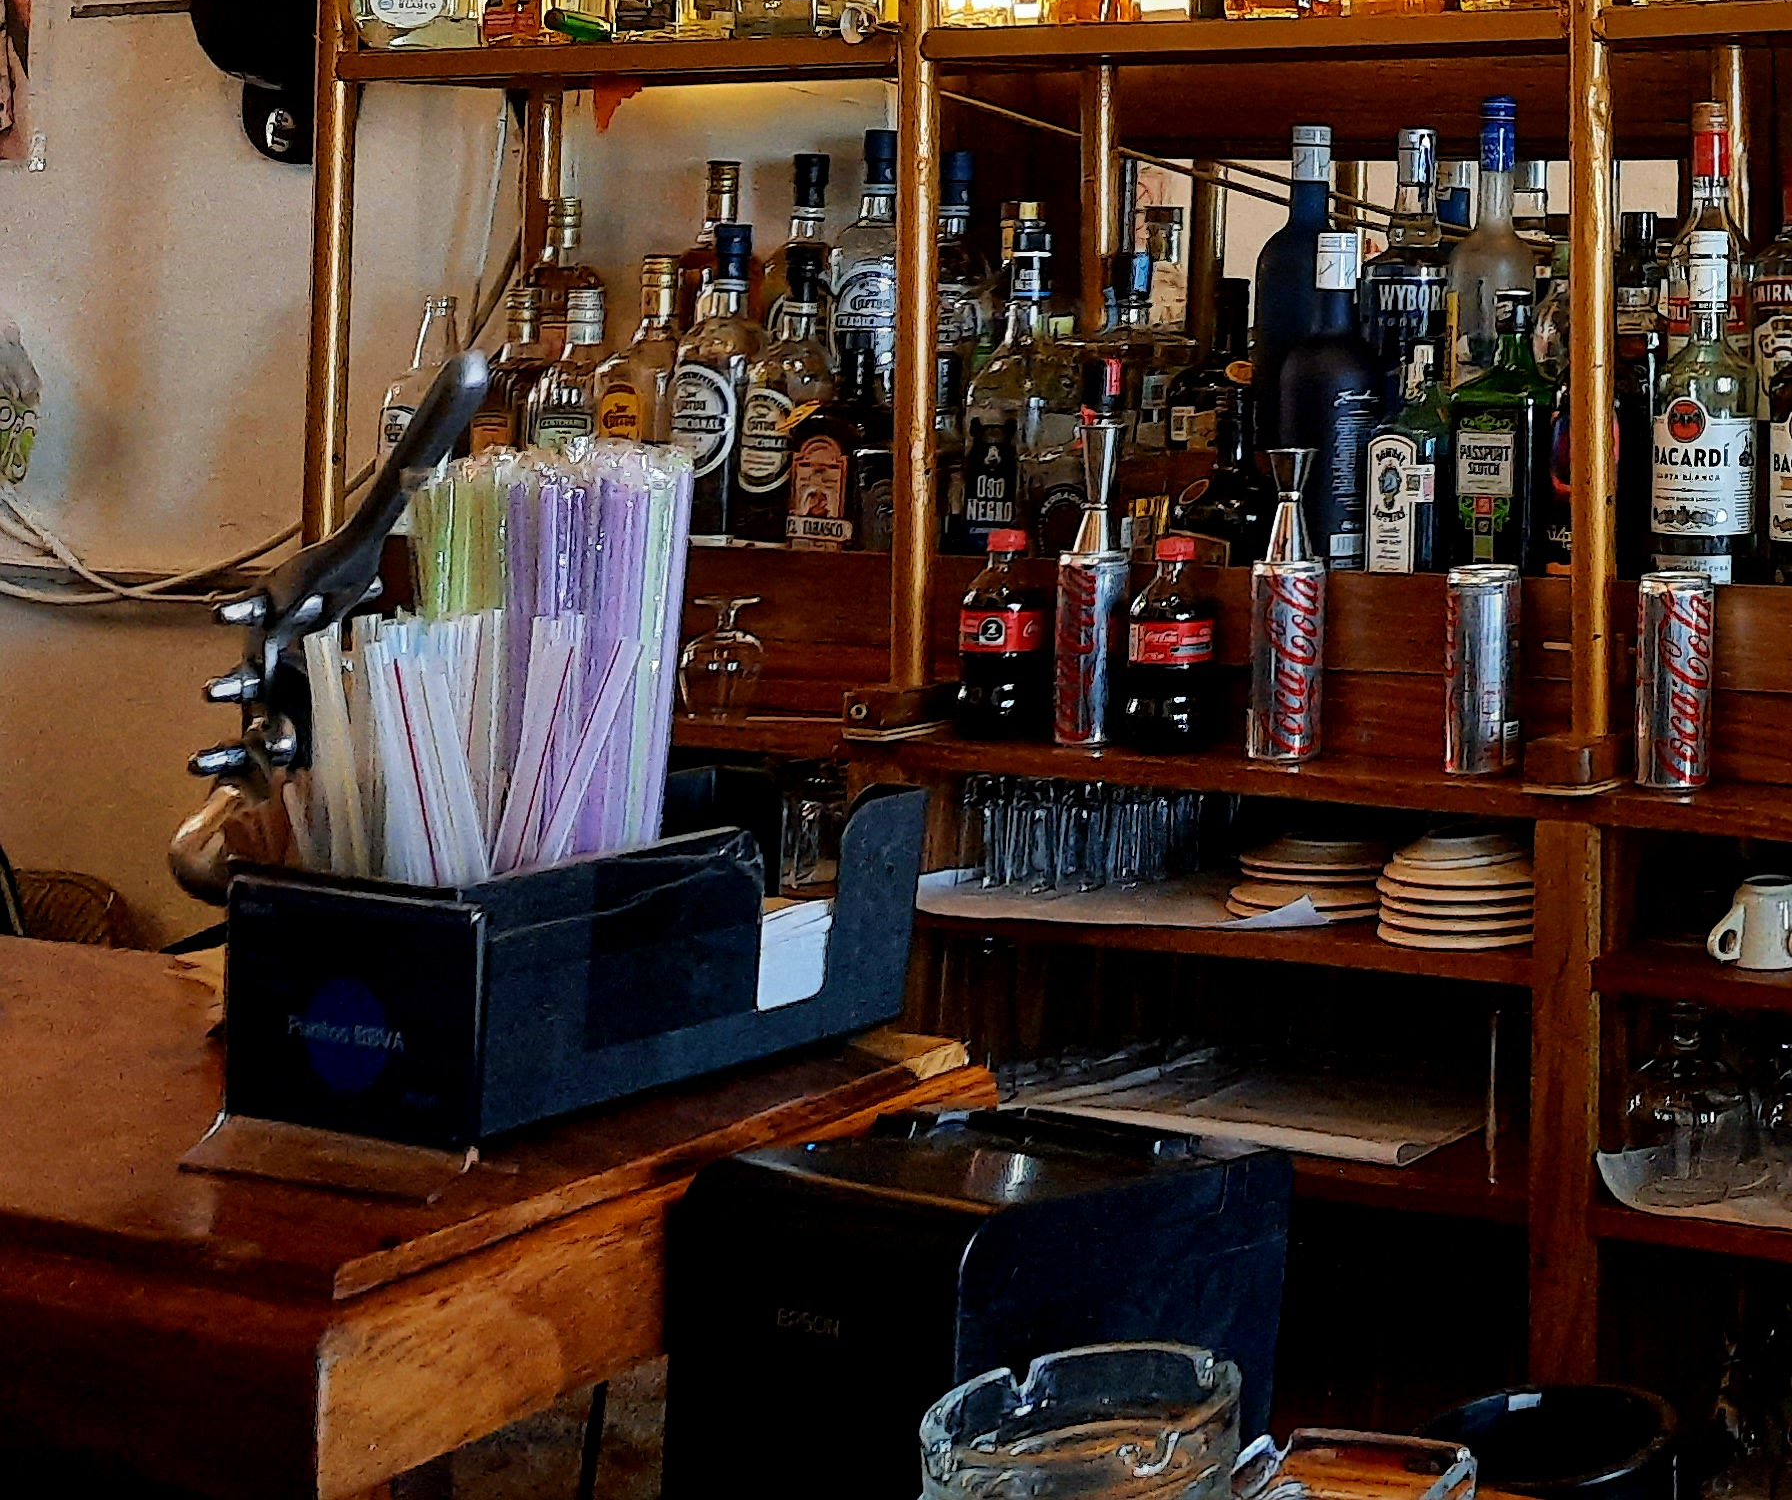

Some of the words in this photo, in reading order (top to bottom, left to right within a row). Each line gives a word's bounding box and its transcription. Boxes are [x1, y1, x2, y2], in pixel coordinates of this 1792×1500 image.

[1378, 284, 1447, 311] WYBOR
[1654, 444, 1731, 468] BACARDÍ
[776, 1307, 840, 1340] EPSON
